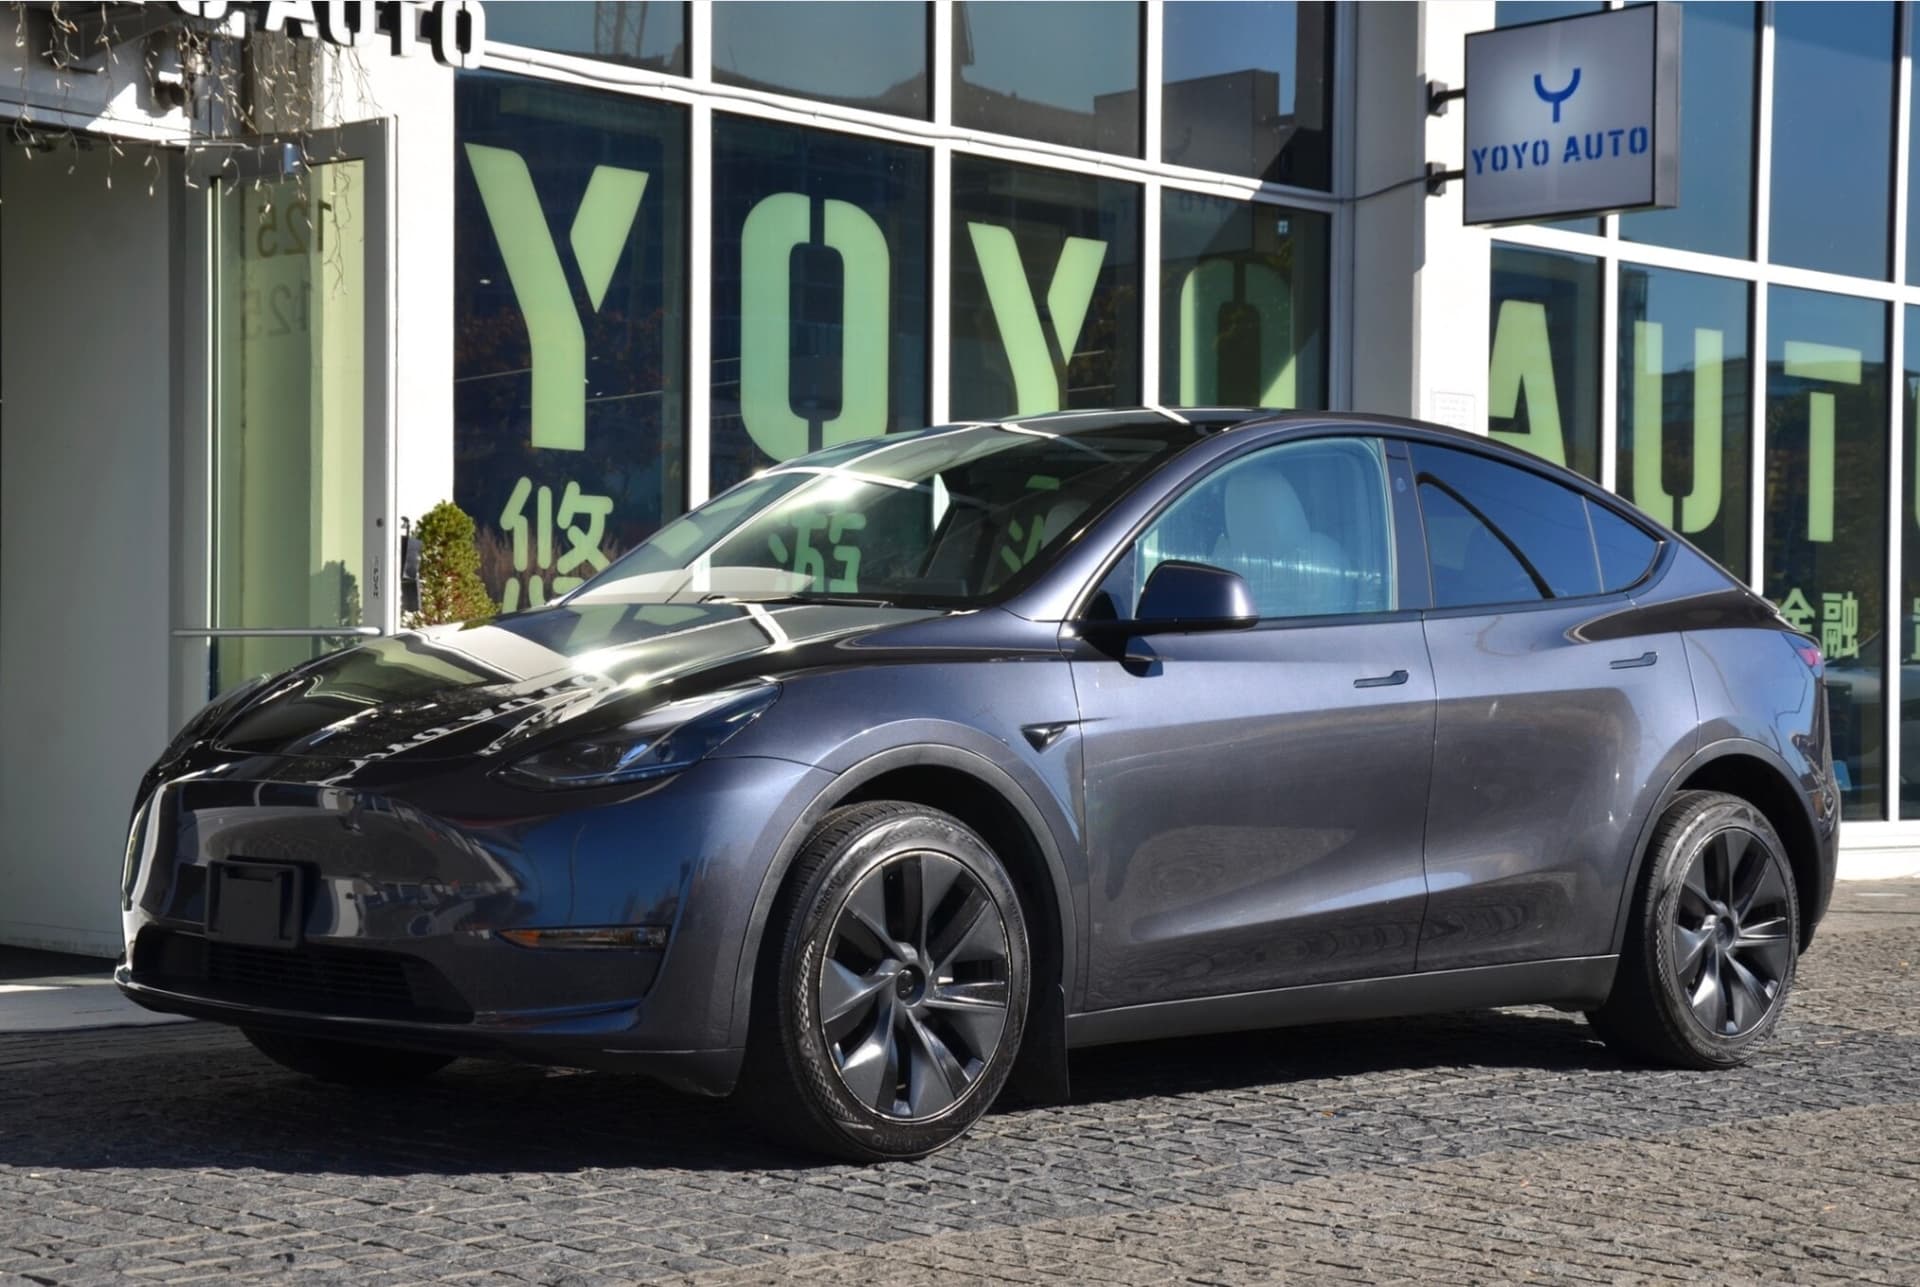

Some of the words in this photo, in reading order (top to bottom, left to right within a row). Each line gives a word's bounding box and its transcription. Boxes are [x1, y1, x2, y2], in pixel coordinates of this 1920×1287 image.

[1472, 139, 1550, 175] YOYO
[1563, 126, 1648, 163] AUTO
[1488, 300, 1920, 542] AUT
[1779, 587, 1859, 659] 金融
